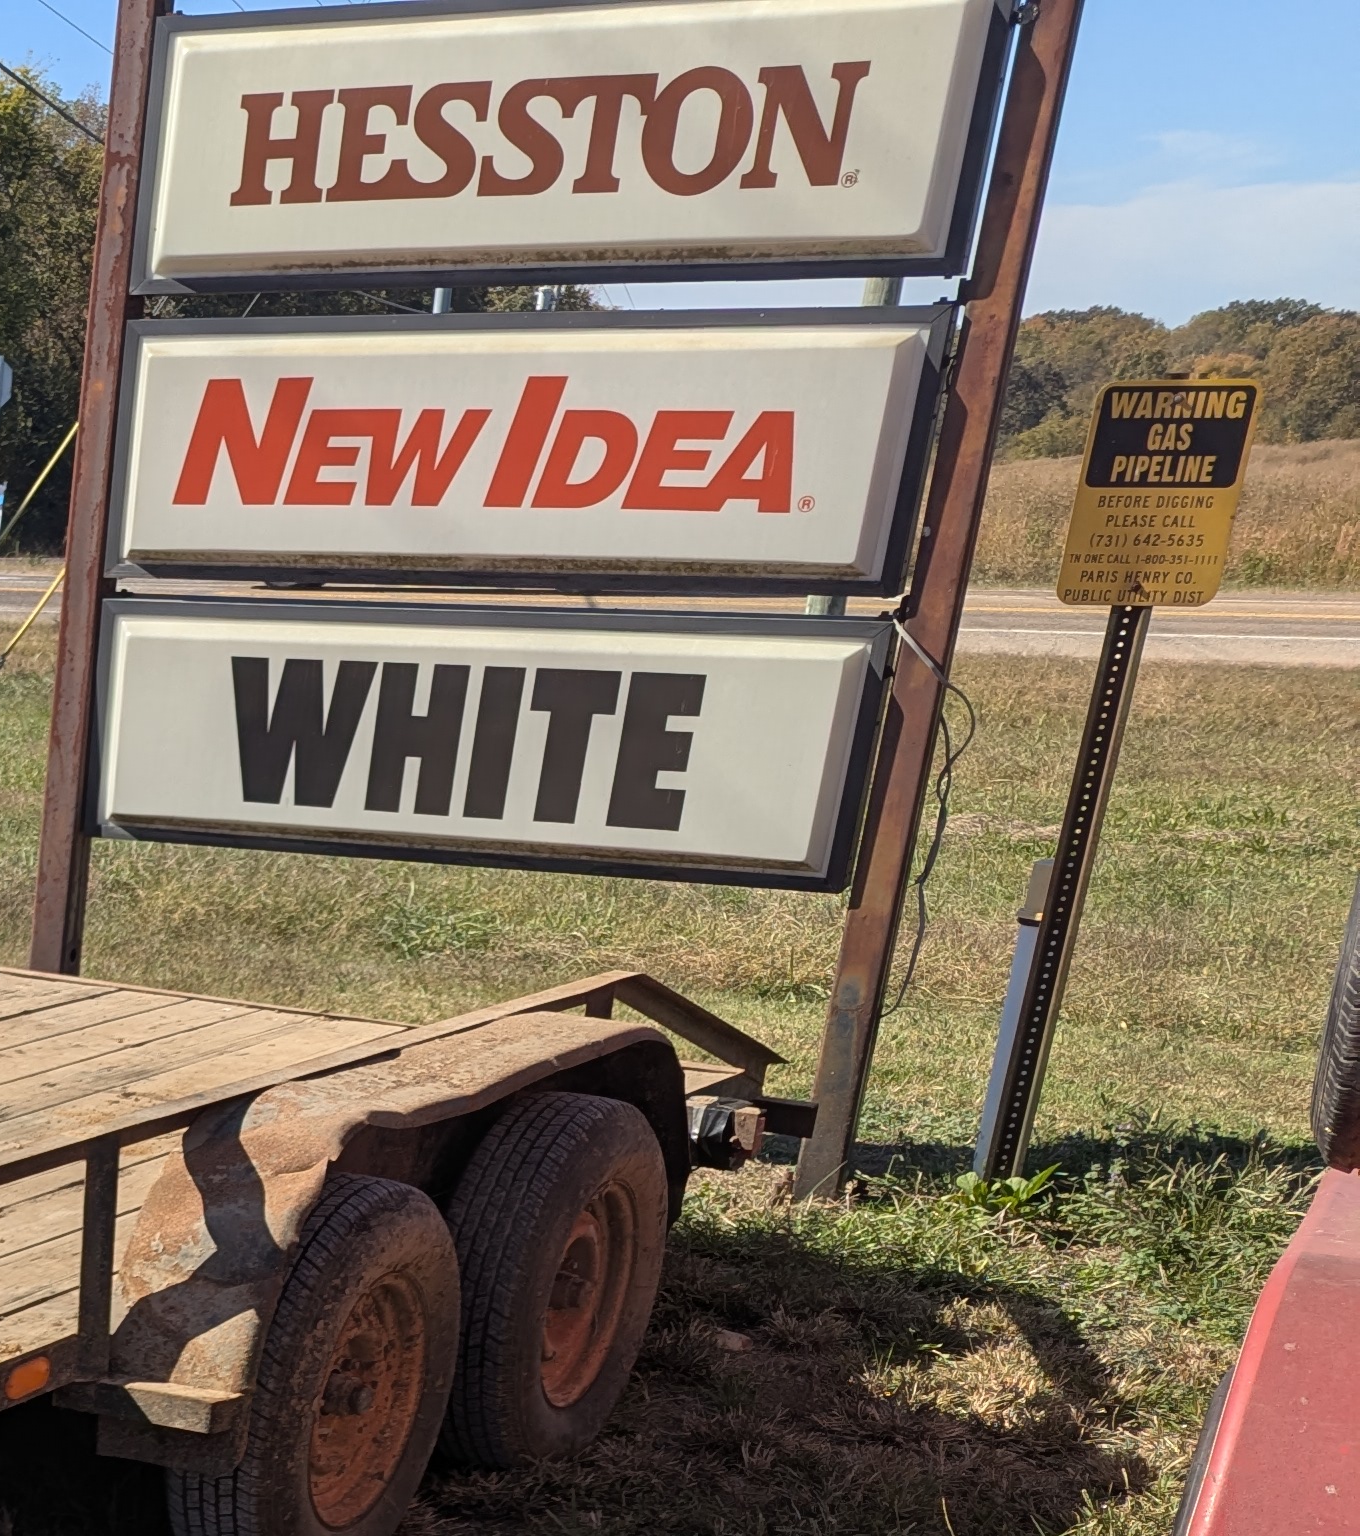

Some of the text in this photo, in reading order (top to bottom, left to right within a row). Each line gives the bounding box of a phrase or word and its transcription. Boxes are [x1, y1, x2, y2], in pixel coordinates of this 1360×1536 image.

[229, 60, 871, 207] HESSTON
[1110, 391, 1248, 419] WARNING
[172, 376, 794, 513] NEW IDEA
[1147, 423, 1194, 451] GAS
[1110, 455, 1217, 483] PIPELINE
[1097, 495, 1215, 509] BEFORE DIGGING
[1105, 515, 1196, 528] PLEASE CALL
[1089, 533, 1205, 548] (731) 642-5635
[1069, 553, 1219, 566] TN ONE CALL 1-800-351-1111
[1080, 570, 1197, 585] PARIS HENRY CO.
[1063, 589, 1112, 601] PUBLIC
[231, 655, 707, 832] WHITE
